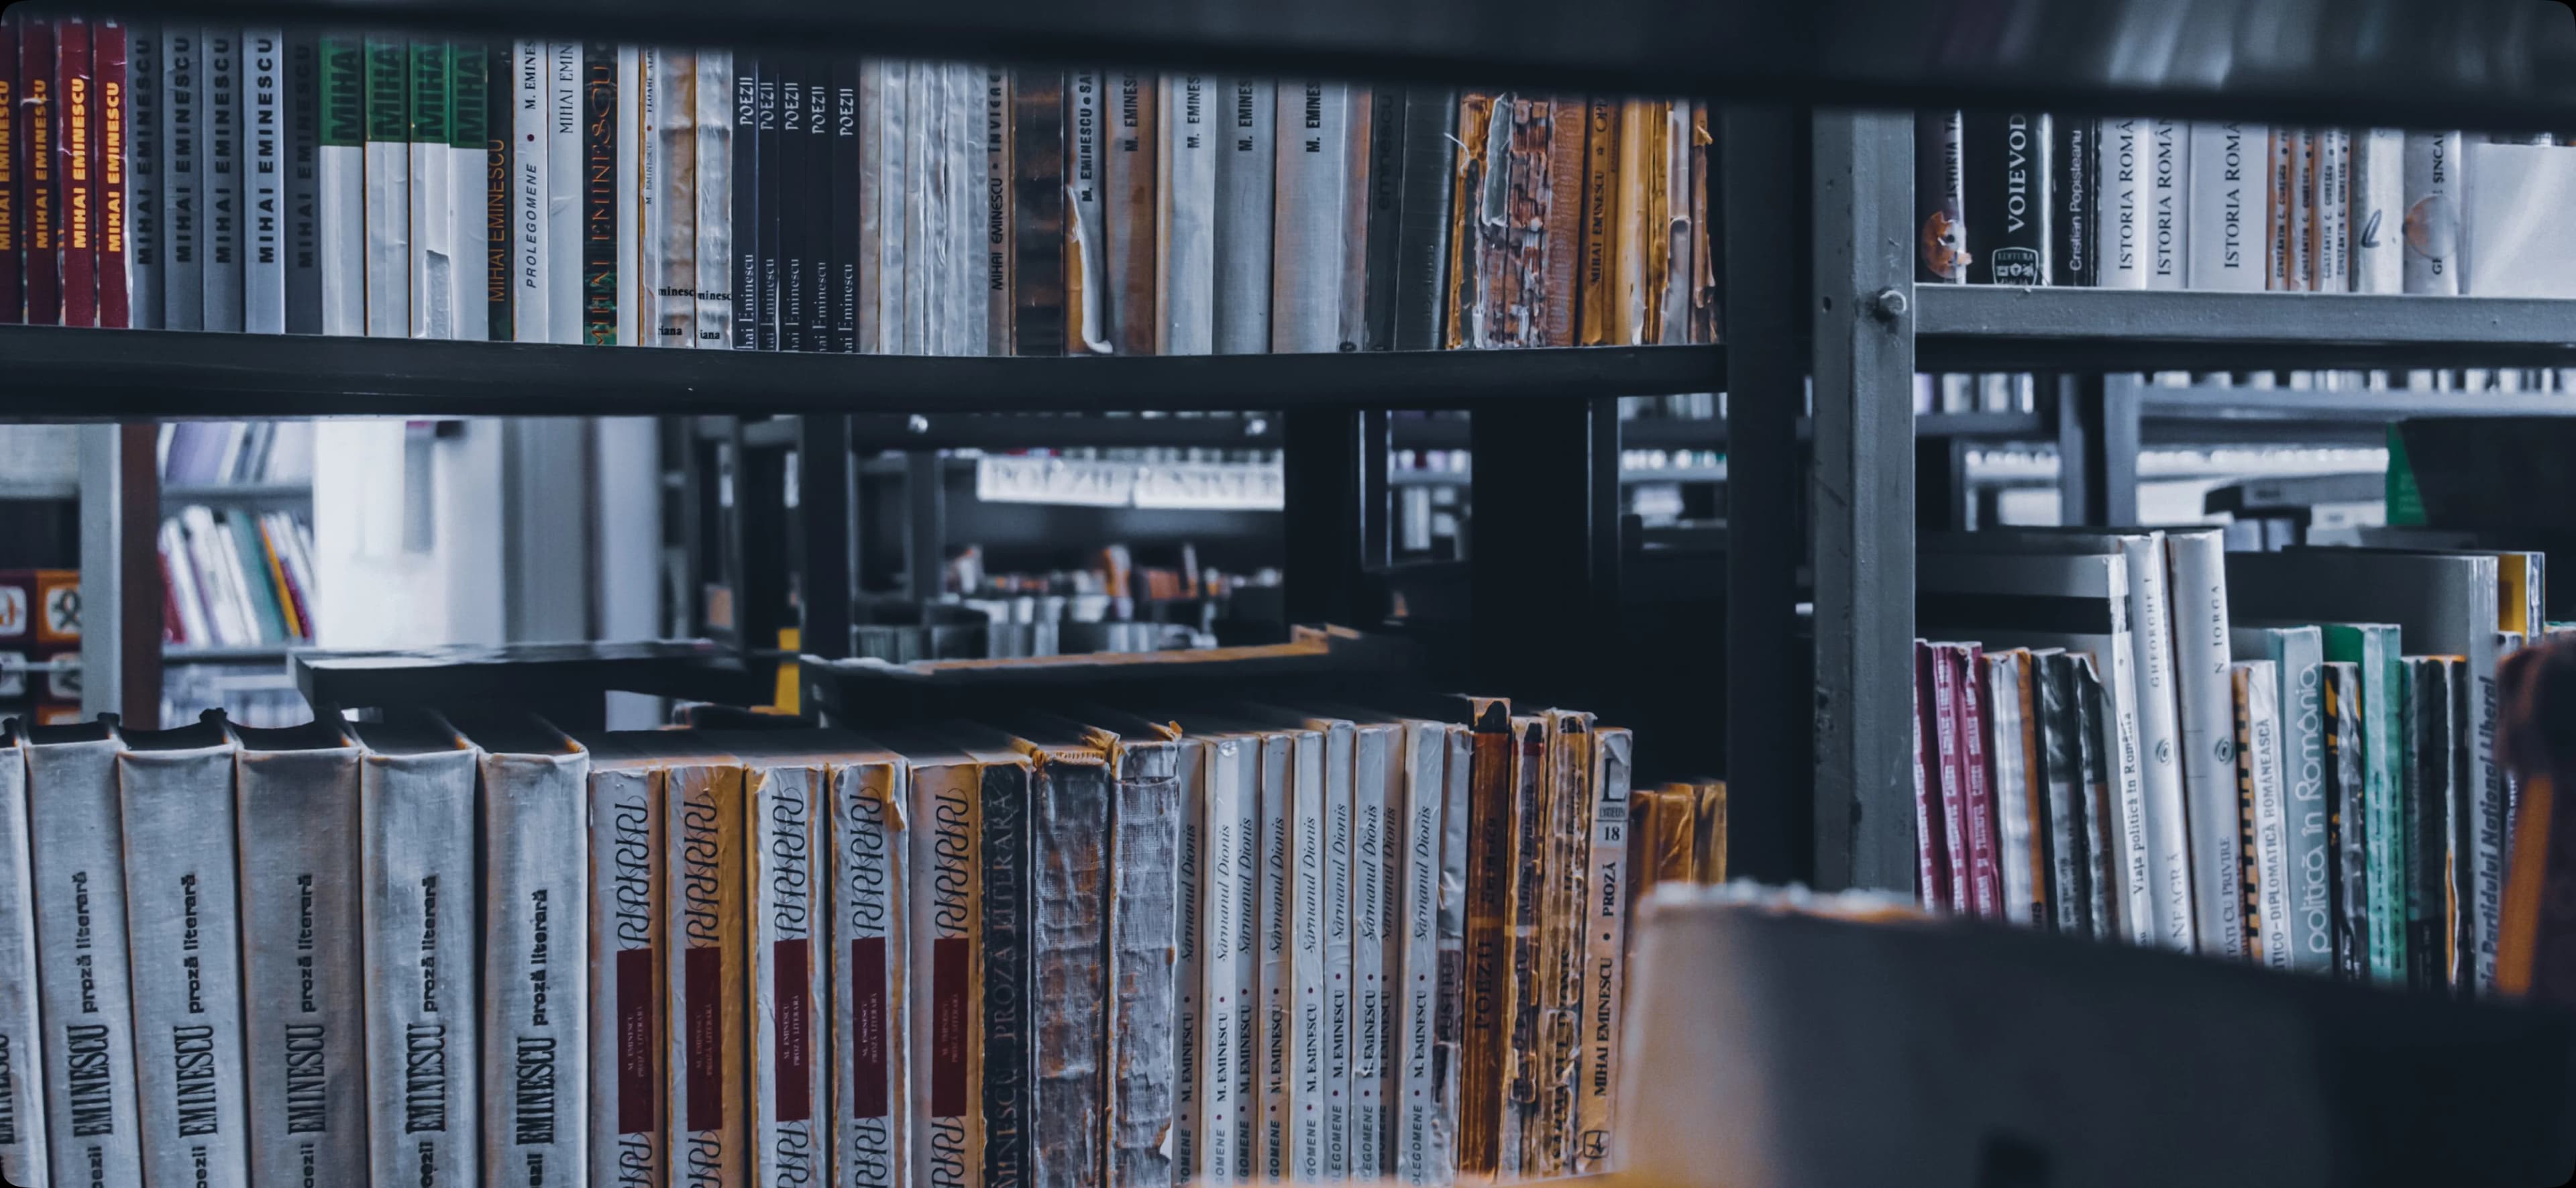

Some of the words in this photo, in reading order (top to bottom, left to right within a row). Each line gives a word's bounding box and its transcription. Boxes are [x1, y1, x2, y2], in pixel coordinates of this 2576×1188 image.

[34, 80, 47, 180] EMINESCU
[72, 78, 85, 180] EMINESCU
[107, 82, 120, 183] EMINESCU
[136, 39, 152, 174] EMINESCU
[174, 38, 191, 172] EMINESCU
[214, 38, 231, 174] EMINESCU
[257, 38, 273, 174] EMINESCU
[296, 45, 313, 178] EMINESCU
[525, 93, 536, 109] M.
[559, 89, 574, 133] MIHAI
[739, 77, 753, 125] POEZII
[760, 82, 774, 131] POEZII
[785, 82, 799, 131] POEZII
[812, 86, 825, 134] POEZII
[840, 88, 854, 136] POEZII
[1187, 72, 1201, 125] EMINES
[1238, 76, 1252, 127] EMINES
[591, 65, 611, 241] EMINESCU
[645, 142, 653, 188] EMINESCU
[1079, 107, 1093, 180] EMINESCU
[1124, 136, 1138, 152] M.
[1187, 133, 1200, 149] M.
[1238, 136, 1252, 152] M.
[1306, 137, 1320, 153] M.
[1378, 94, 1394, 211] eminescu
[36, 188, 48, 248] MIHAI
[73, 188, 87, 248] MIHAI
[108, 191, 121, 252] MIHAI
[488, 139, 504, 241] EMINESCU
[991, 178, 1003, 244] EMINESCU
[1081, 187, 1093, 202] M.
[1593, 170, 1606, 235] EMINESCU
[137, 189, 153, 264] MIHAI
[176, 187, 192, 262] MIHAI
[215, 188, 231, 264] MIHAI
[258, 188, 274, 263] MIHAI
[297, 193, 313, 267] MIHAI
[526, 163, 537, 288] PROLEGOMENE
[2069, 217, 2082, 270] Cristian
[2119, 189, 2133, 270] ISTORIA
[2157, 196, 2171, 276] ISTORIA
[2224, 188, 2240, 269] ISTORIA
[488, 247, 505, 301] MIHAI
[739, 254, 754, 321] Eminescu
[760, 258, 775, 326] Eminescu
[785, 258, 800, 326] Eminescu
[812, 262, 828, 329] Eminescu
[838, 264, 853, 332] Eminescu
[992, 252, 1003, 290] MIHAI
[1590, 243, 1603, 285] MIHAI
[2145, 594, 2160, 688] GHEORGHE
[2211, 584, 2223, 646] IORGA
[2295, 663, 2324, 800] România
[2478, 675, 2497, 750] Liberal
[1601, 758, 1627, 802] L
[2125, 779, 2137, 794] în
[2255, 718, 2275, 818] ROMÂNEASCĂ
[2479, 754, 2499, 848] Național
[1181, 824, 1197, 878] Dionis
[1216, 825, 1231, 878] Dionis
[1238, 817, 1253, 871] Dionis
[1269, 817, 1285, 871] Dionis
[1302, 816, 1318, 869] Dionis
[1332, 803, 1348, 856] Dionis
[1362, 804, 1378, 857] Dionis
[1382, 806, 1397, 860] Dionis
[1416, 806, 1432, 859] Dionis
[1604, 826, 1620, 842] 18
[2125, 798, 2145, 851] politică
[2301, 811, 2323, 838] în
[1331, 861, 1347, 940] Sărmanul
[1601, 861, 1618, 918] PROZĂ
[2132, 856, 2145, 895] Viața
[2167, 852, 2186, 938] NEAGRĂ
[2219, 838, 2234, 896] PRIVIRE
[2299, 846, 2332, 954] politică
[70, 871, 92, 949] literară
[180, 874, 199, 951] literară
[297, 874, 314, 951] literară
[421, 875, 437, 951] literară
[531, 889, 549, 965] literară
[1179, 883, 1196, 963] Sărmanul
[1216, 882, 1230, 963] Sărmanul
[1238, 875, 1253, 956] Sărmanul
[1268, 875, 1284, 955] Sărmanul
[1301, 874, 1318, 954] Sărmanul
[1361, 861, 1377, 942] Sărmanul
[1413, 862, 1431, 942] Sărmanul
[2222, 900, 2235, 922] CU
[2479, 852, 2500, 957] Partidului
[80, 955, 99, 1014] proză
[188, 955, 205, 1014] proză
[300, 955, 316, 1014] proză
[421, 955, 439, 1013] proză
[532, 968, 549, 1027] proză
[792, 994, 800, 1035] LITERARĂ
[1474, 940, 1493, 1032] POEZII
[1597, 957, 1613, 1040] EMINESCU
[1182, 1012, 1194, 1083] EMINESCU
[1217, 1012, 1229, 1083] EMINESCU
[1240, 1004, 1252, 1075] EMINESCU
[1270, 1004, 1283, 1075] EMINESCU
[1305, 1004, 1318, 1074] EMINESCU
[1332, 989, 1346, 1059] EMINESCU
[1363, 989, 1377, 1059] EMINESCU
[1379, 990, 1391, 1060] EMINESCU
[1415, 989, 1428, 1059] EMINESCU
[66, 1024, 114, 1138] EMINESCU
[173, 1025, 219, 1139] EMINESCU
[285, 1024, 327, 1136] EMINESCU
[406, 1023, 447, 1134] EMINESCU
[516, 1036, 557, 1146] EMINESCU
[1182, 1086, 1193, 1103] M.
[1217, 1085, 1228, 1102] M.
[1240, 1077, 1251, 1094] M.
[1270, 1077, 1283, 1094] M.
[1306, 1077, 1318, 1093] M.
[1333, 1062, 1345, 1079] M.
[1413, 1062, 1426, 1079] M.
[1594, 1040, 1609, 1097] MIHAI
